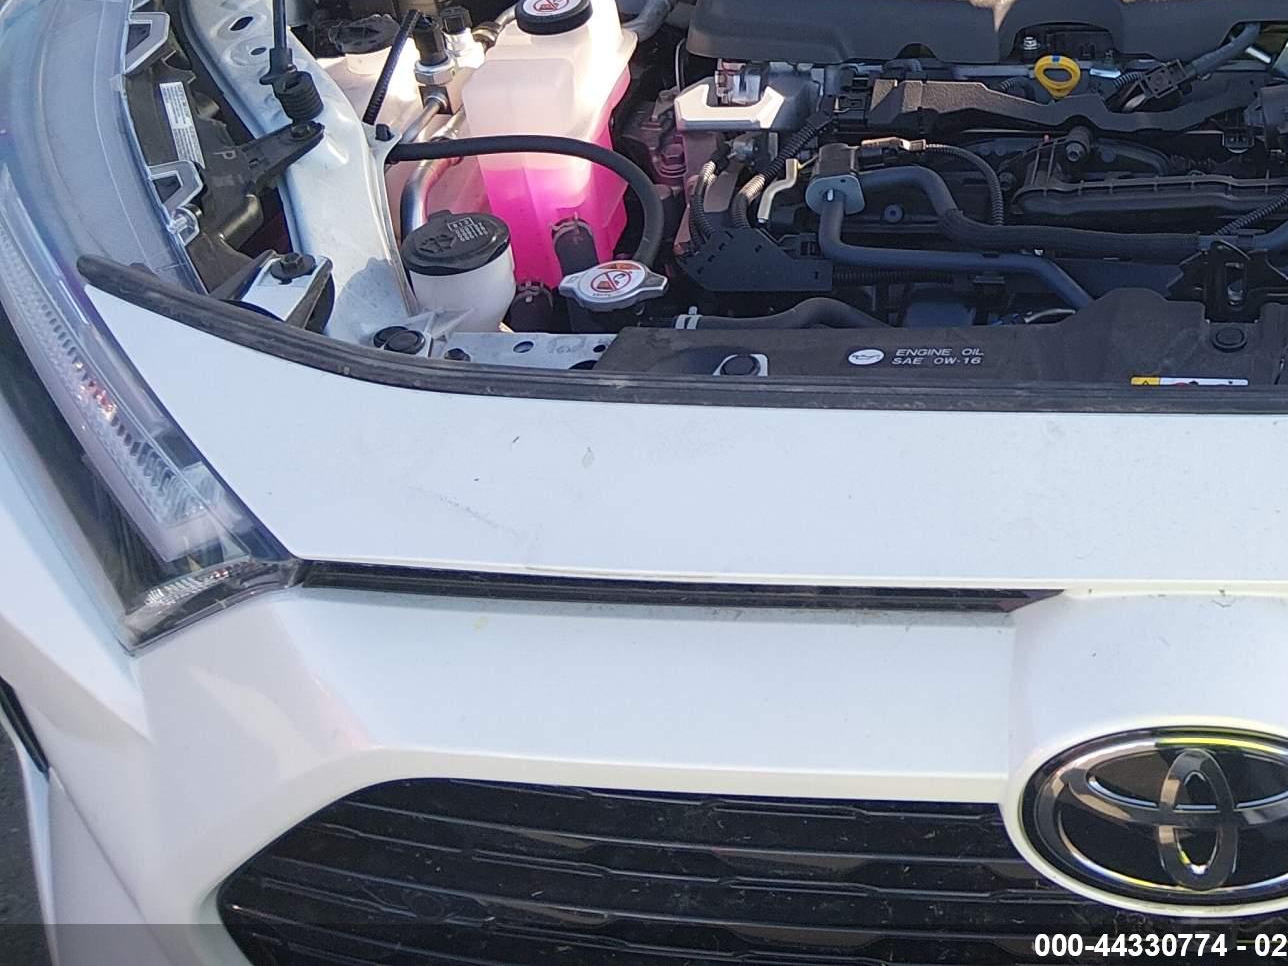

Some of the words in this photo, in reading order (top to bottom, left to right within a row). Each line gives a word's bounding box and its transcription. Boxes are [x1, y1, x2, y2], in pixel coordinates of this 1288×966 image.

[895, 348, 952, 356] ENGINE
[961, 348, 985, 356] OIL
[891, 357, 924, 365] SAE
